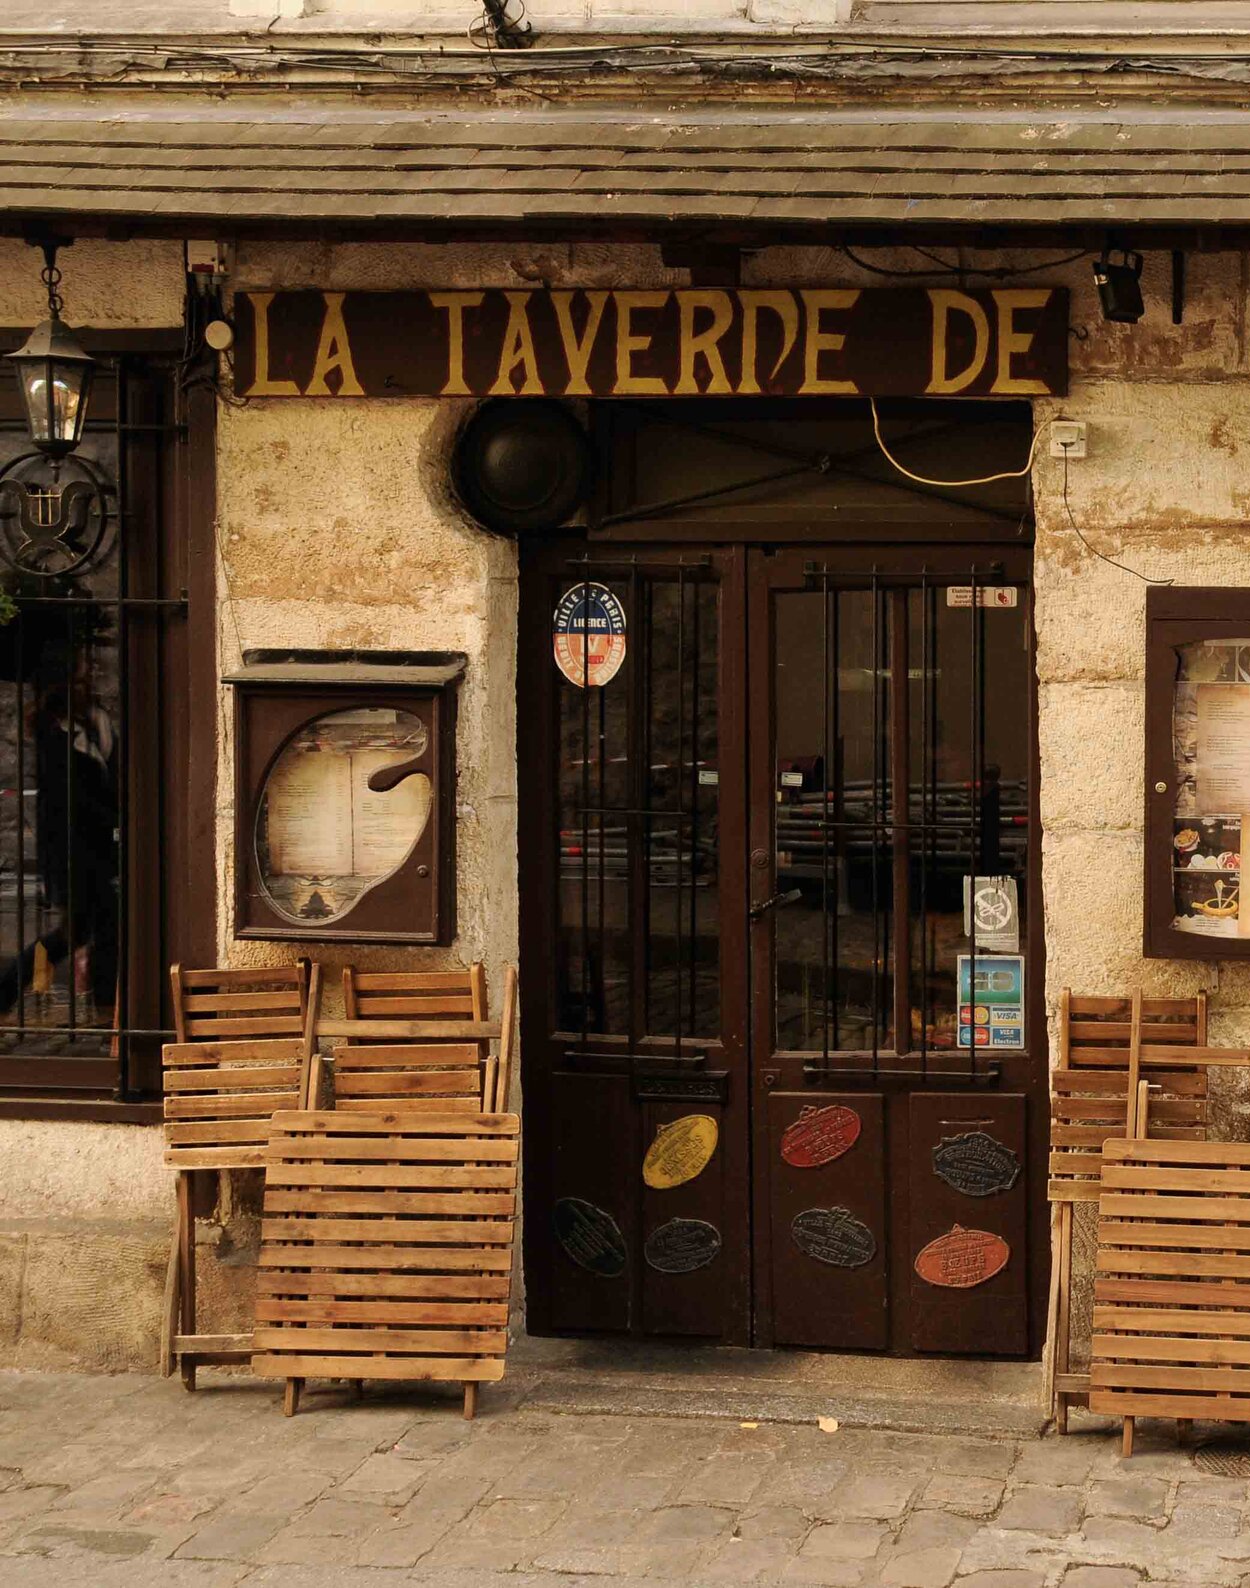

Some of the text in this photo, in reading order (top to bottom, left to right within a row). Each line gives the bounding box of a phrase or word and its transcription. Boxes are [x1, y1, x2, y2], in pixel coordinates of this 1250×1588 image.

[245, 288, 1052, 396] LA TAVERNE DE
[558, 593, 580, 628] VILLE
[600, 593, 622, 629] PARIS
